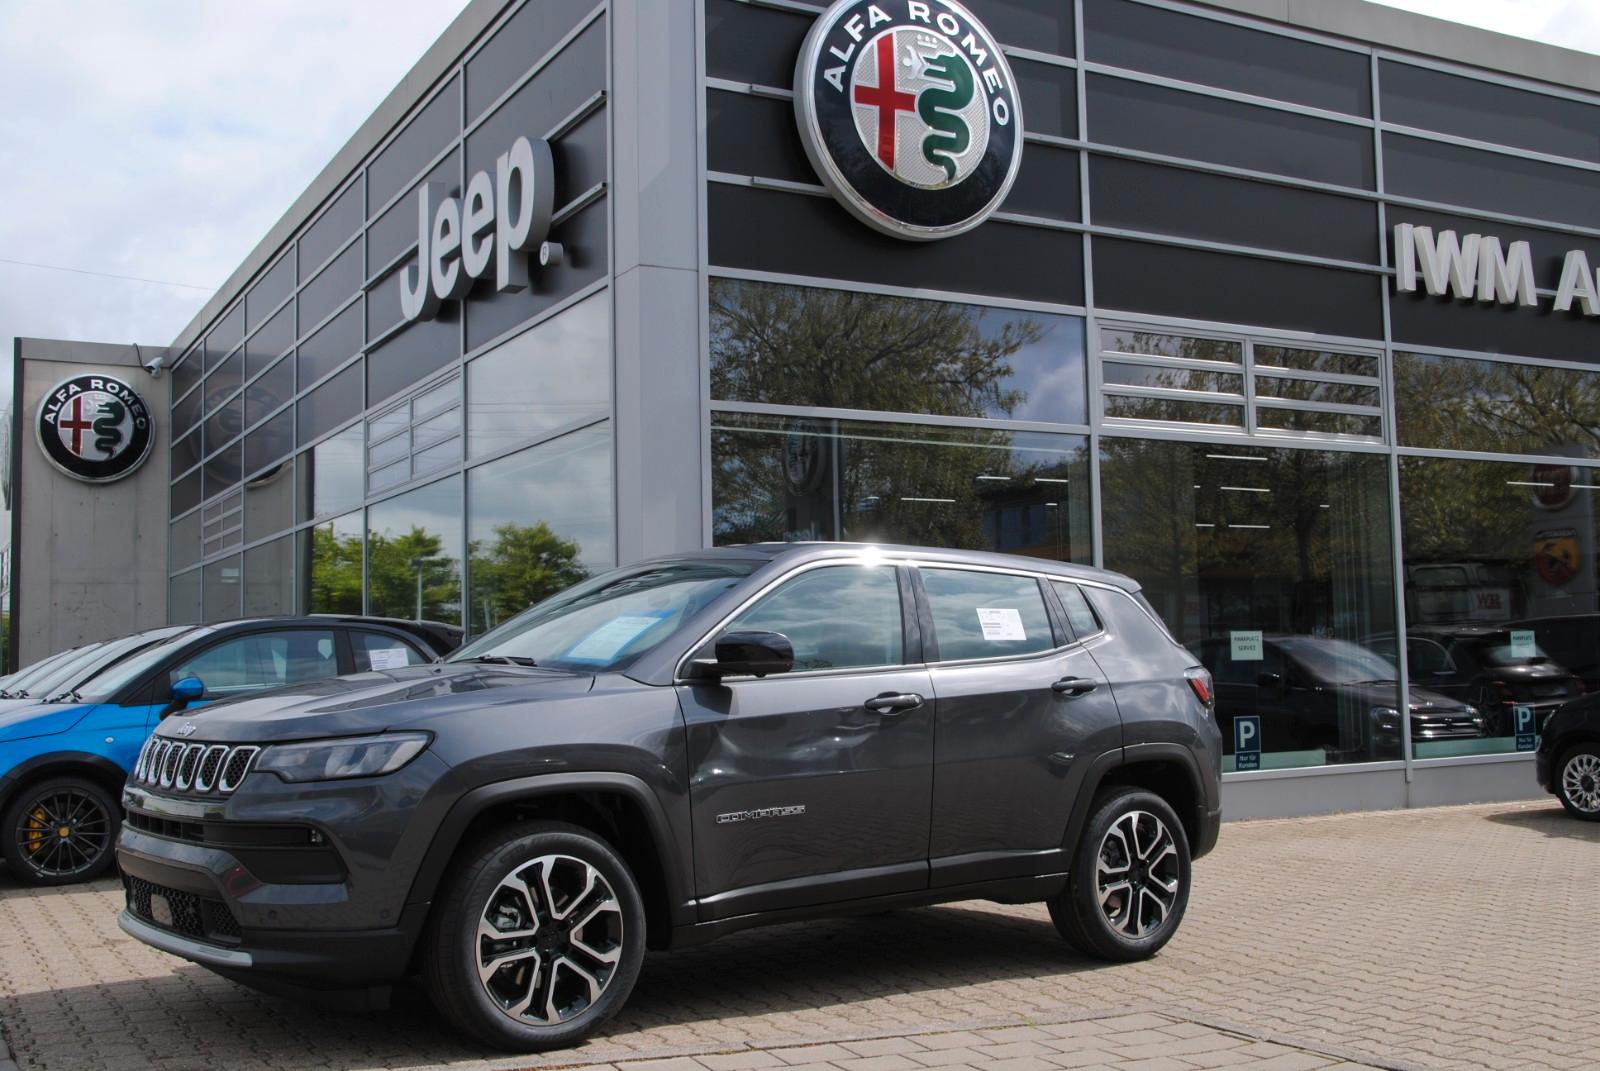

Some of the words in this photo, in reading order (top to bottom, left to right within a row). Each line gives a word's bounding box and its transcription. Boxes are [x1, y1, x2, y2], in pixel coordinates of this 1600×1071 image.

[824, 5, 892, 93] ALFA
[908, 0, 1009, 126] ROMEO
[400, 136, 550, 321] Jeep
[1394, 222, 1538, 307] IWM
[1553, 250, 1600, 316] A
[44, 383, 82, 424] ALFA
[90, 379, 147, 430] ROMEO
[1239, 720, 1255, 748] P
[1518, 707, 1531, 731] P
[715, 804, 806, 824] COMPASS
